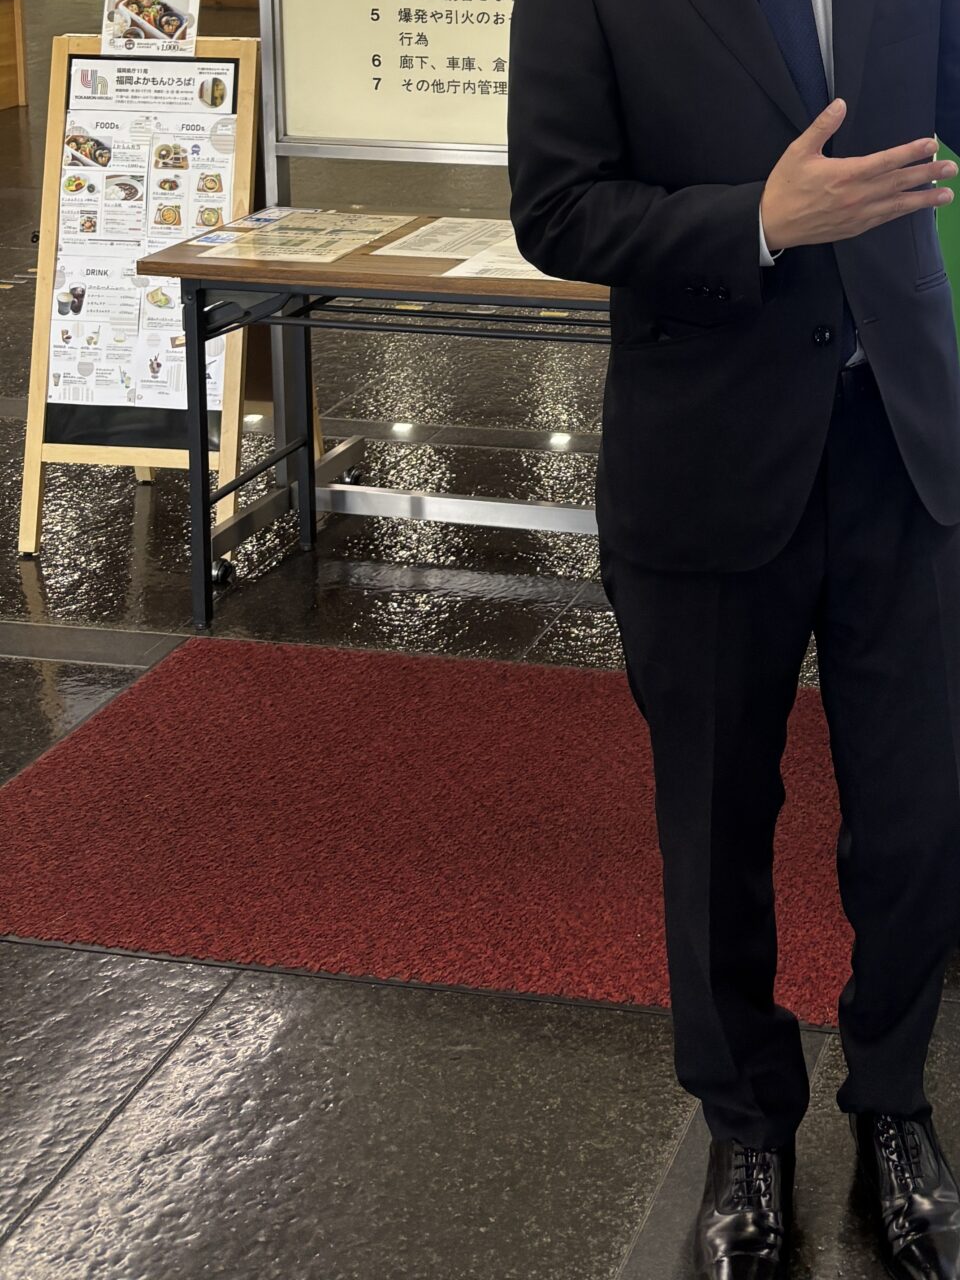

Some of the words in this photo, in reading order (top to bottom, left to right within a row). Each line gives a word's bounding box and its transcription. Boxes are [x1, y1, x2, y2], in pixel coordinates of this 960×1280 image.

[370, 8, 380, 21] 5
[397, 7, 512, 25] 爆発や引火のお
[399, 31, 429, 47] 行為
[371, 54, 382, 67] 6
[372, 77, 382, 90] 7
[401, 78, 508, 96] その他庁内管理
[85, 268, 109, 276] DRINK
